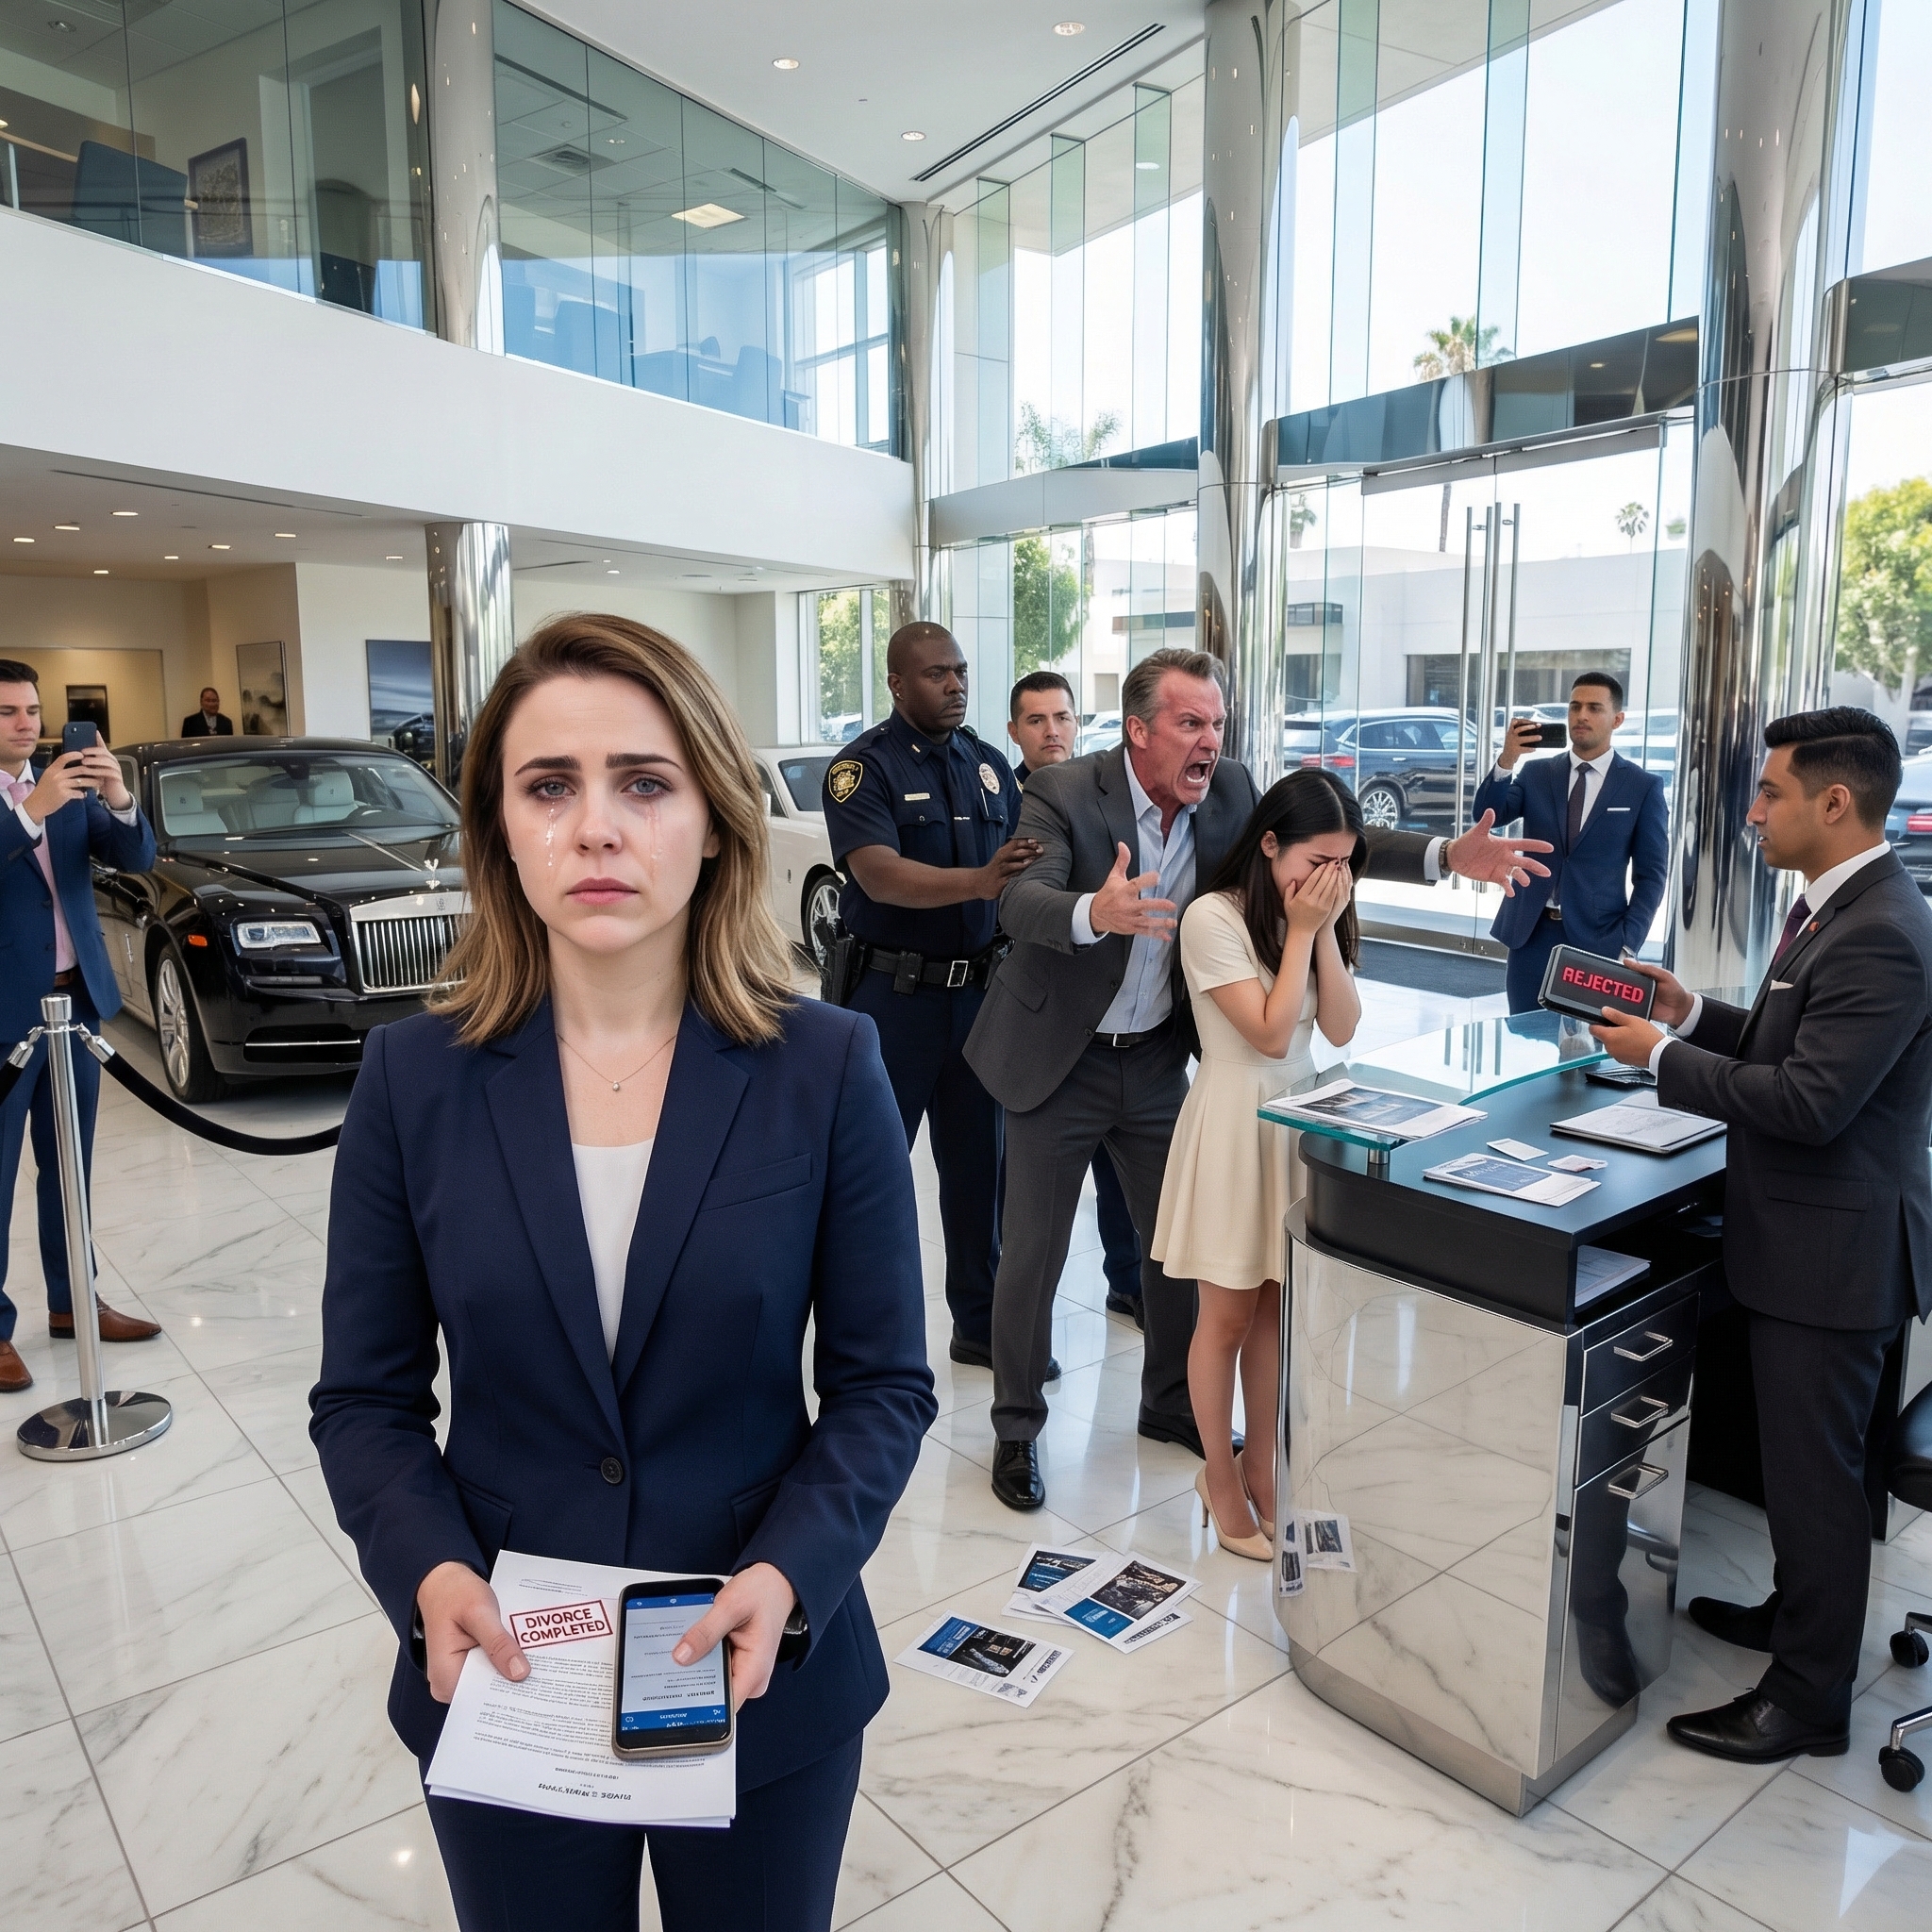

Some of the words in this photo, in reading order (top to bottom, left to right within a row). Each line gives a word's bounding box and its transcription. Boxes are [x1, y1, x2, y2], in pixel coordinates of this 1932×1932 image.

[1562, 966, 1644, 1004] REJECTED
[525, 1607, 592, 1629] DIVORCE
[520, 1620, 605, 1643] COMPLETED
